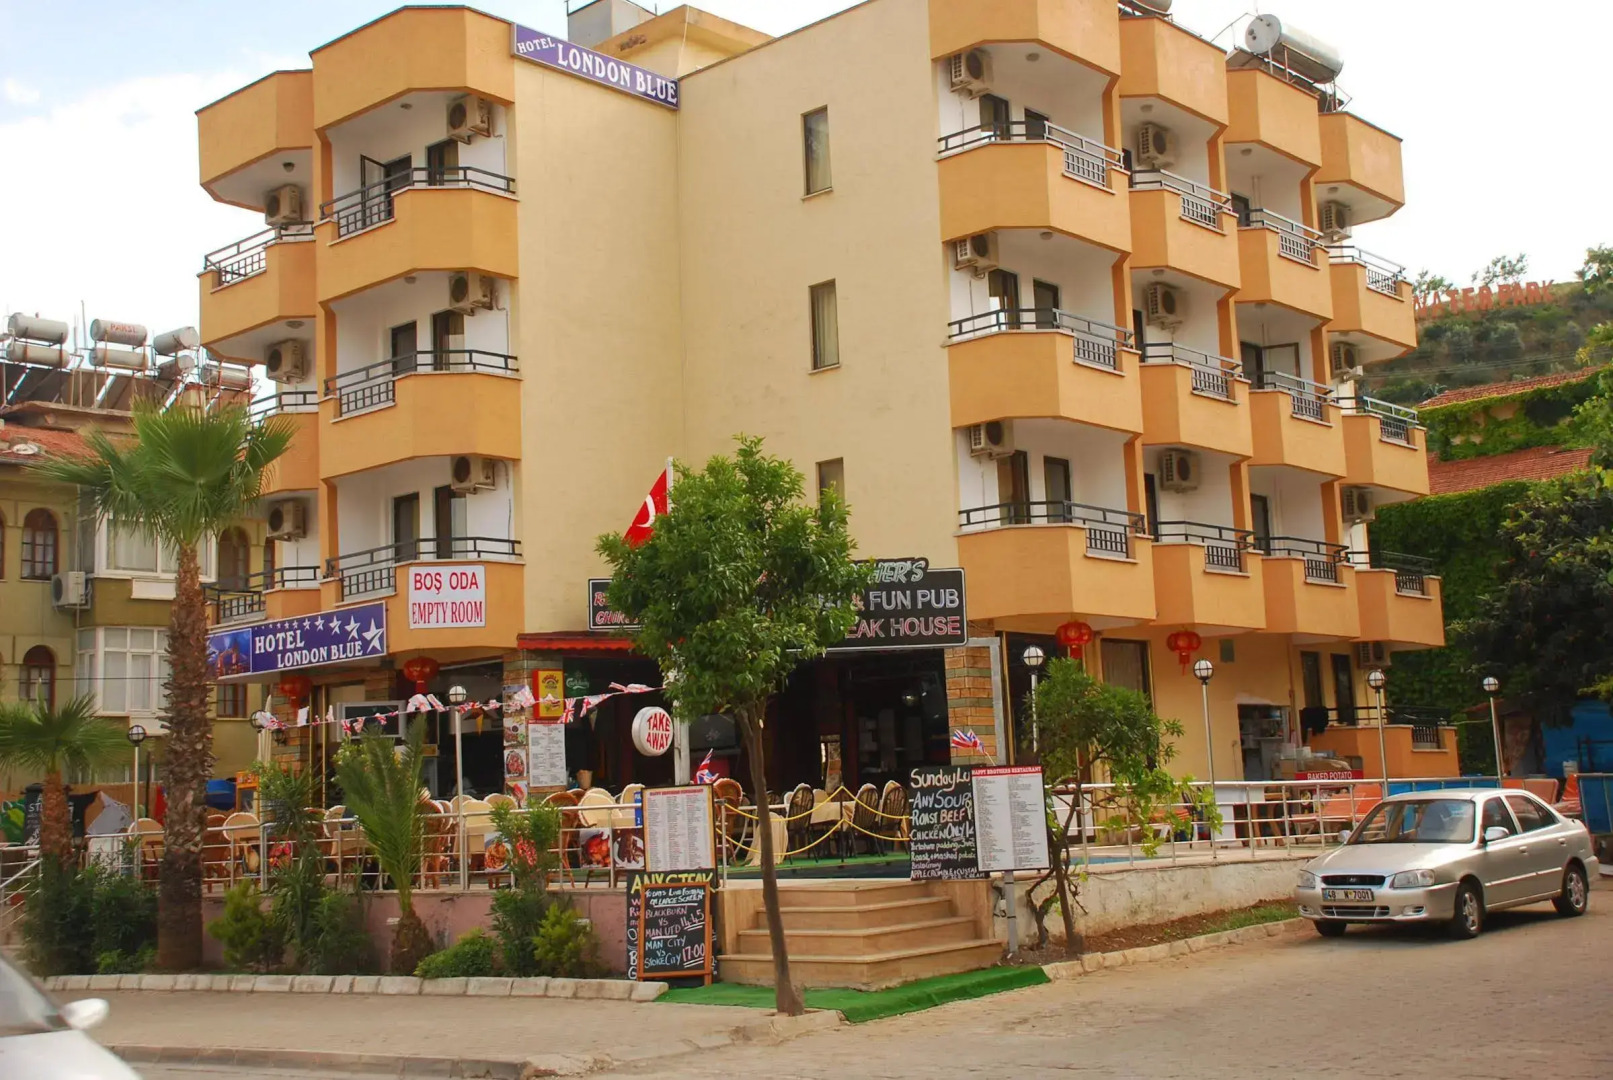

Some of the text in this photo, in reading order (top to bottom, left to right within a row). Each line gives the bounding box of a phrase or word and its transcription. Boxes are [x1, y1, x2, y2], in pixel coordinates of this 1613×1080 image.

[517, 37, 677, 104] HOTEL LONDON BLUE
[1497, 279, 1555, 306] PARK
[414, 572, 479, 595] BOŞ ODA
[869, 590, 911, 611] FUN
[916, 588, 960, 609] PUB
[412, 601, 483, 624] EMPTY ROOM
[845, 615, 961, 639] EAK HOUSE
[255, 629, 305, 654] HOTEL
[277, 640, 363, 668] LONDON BLUE
[646, 712, 671, 731] TAKE
[646, 731, 670, 750] AWAY
[910, 768, 956, 791] Sunday
[1307, 771, 1353, 780] BAKED POTATO
[934, 790, 971, 808] SOUP
[940, 808, 966, 823] BEEF
[1328, 890, 1337, 899] 48
[1353, 890, 1370, 900] 7001
[645, 905, 688, 919] BLACKBURN
[645, 927, 662, 938] MAN
[664, 924, 681, 936] UTD
[645, 939, 663, 951] MAN
